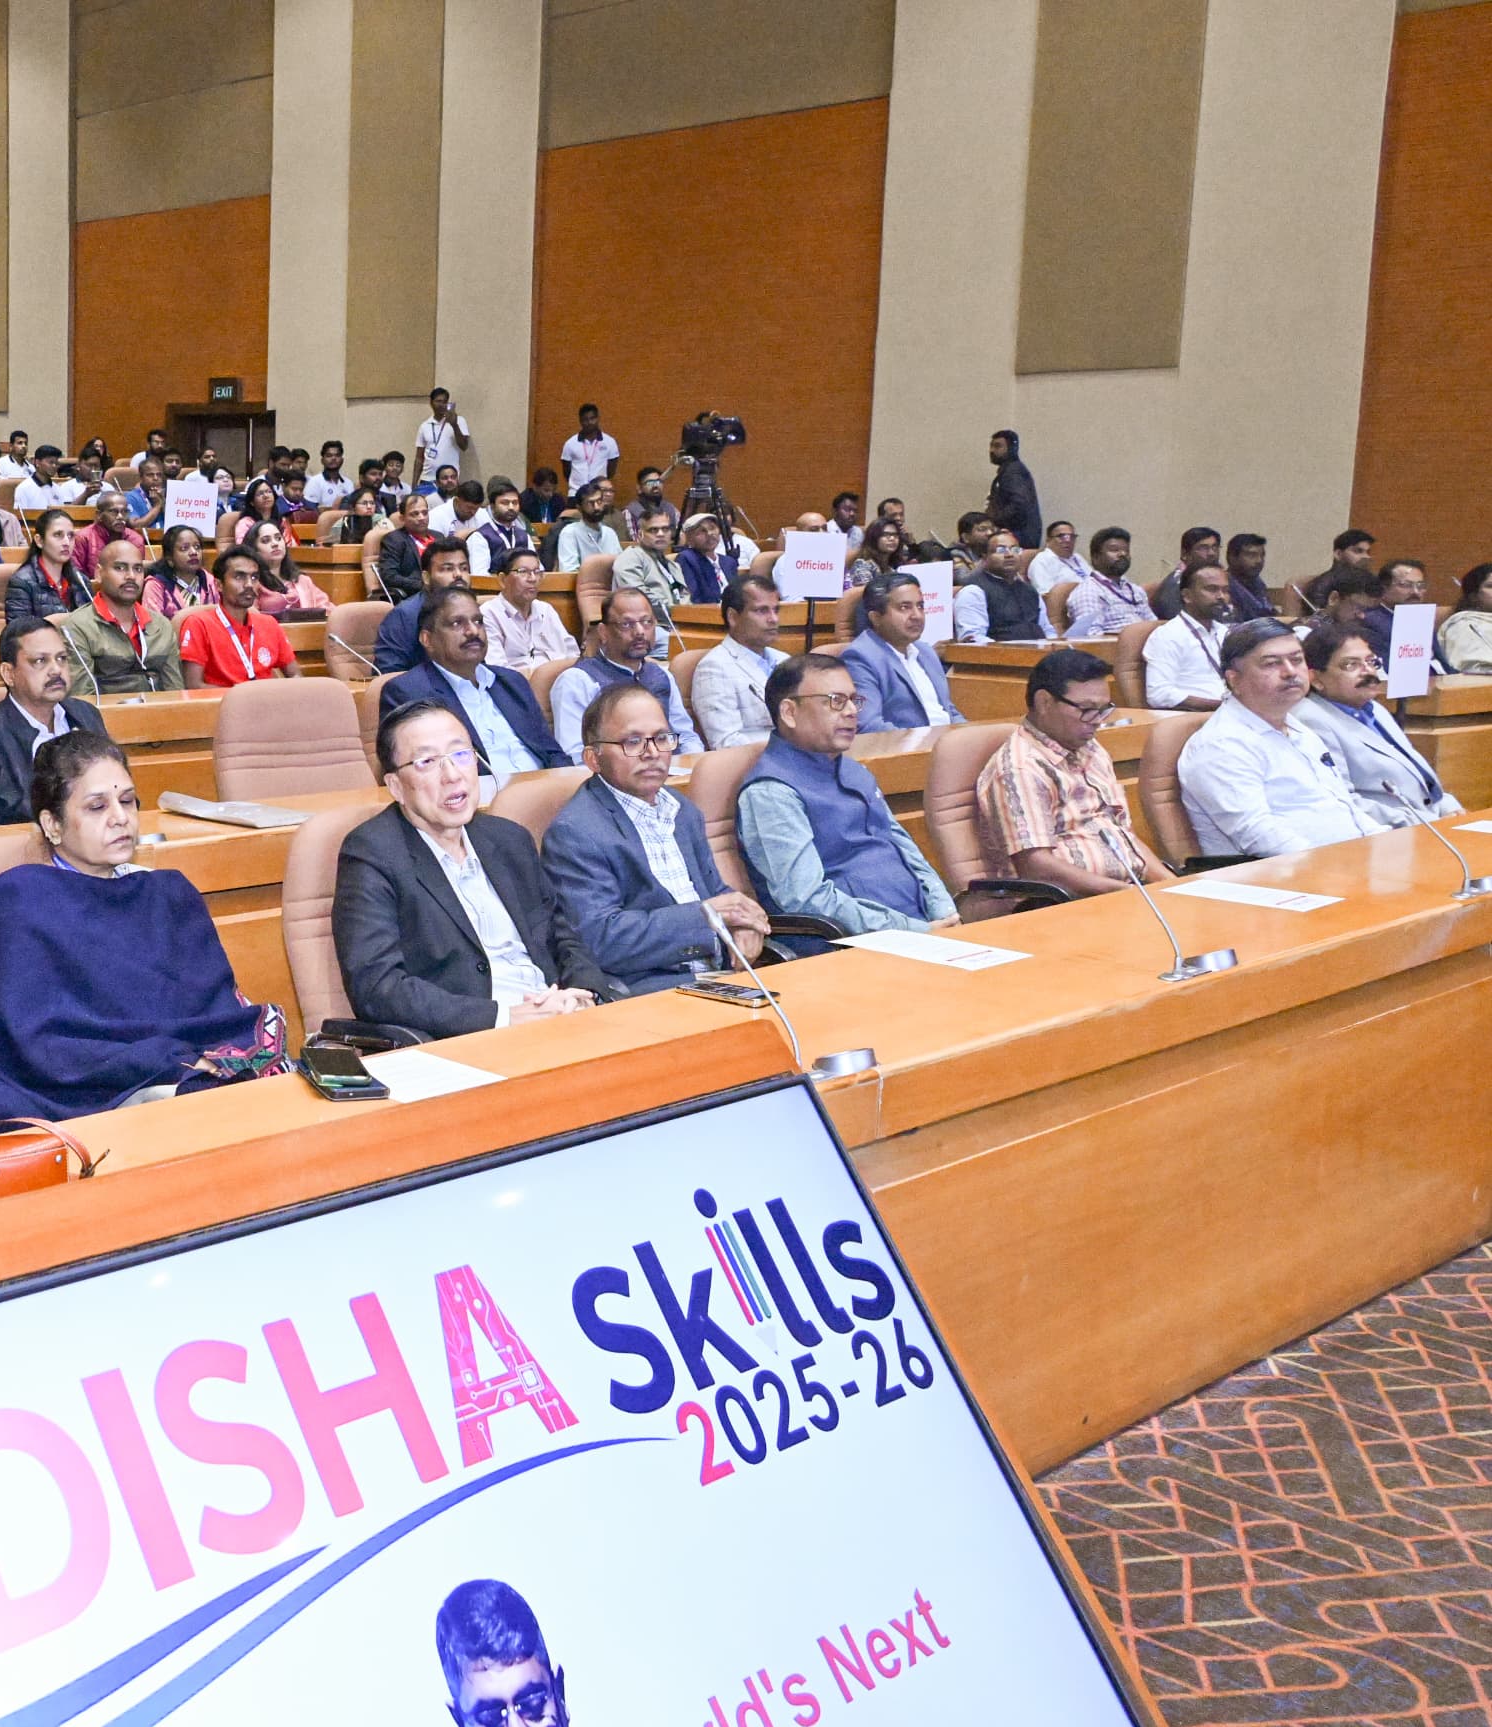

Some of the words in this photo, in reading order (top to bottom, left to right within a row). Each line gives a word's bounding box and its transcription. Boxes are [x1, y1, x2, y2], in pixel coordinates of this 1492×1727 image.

[215, 386, 233, 397] EXIT
[174, 497, 192, 508] Jury
[194, 498, 210, 507] and
[176, 509, 206, 520] Experts
[795, 560, 834, 572] Officials
[1398, 644, 1424, 659] Officials
[571, 1187, 896, 1414] Skills
[675, 1317, 934, 1488] 2025-26
[816, 1586, 951, 1704] Next
